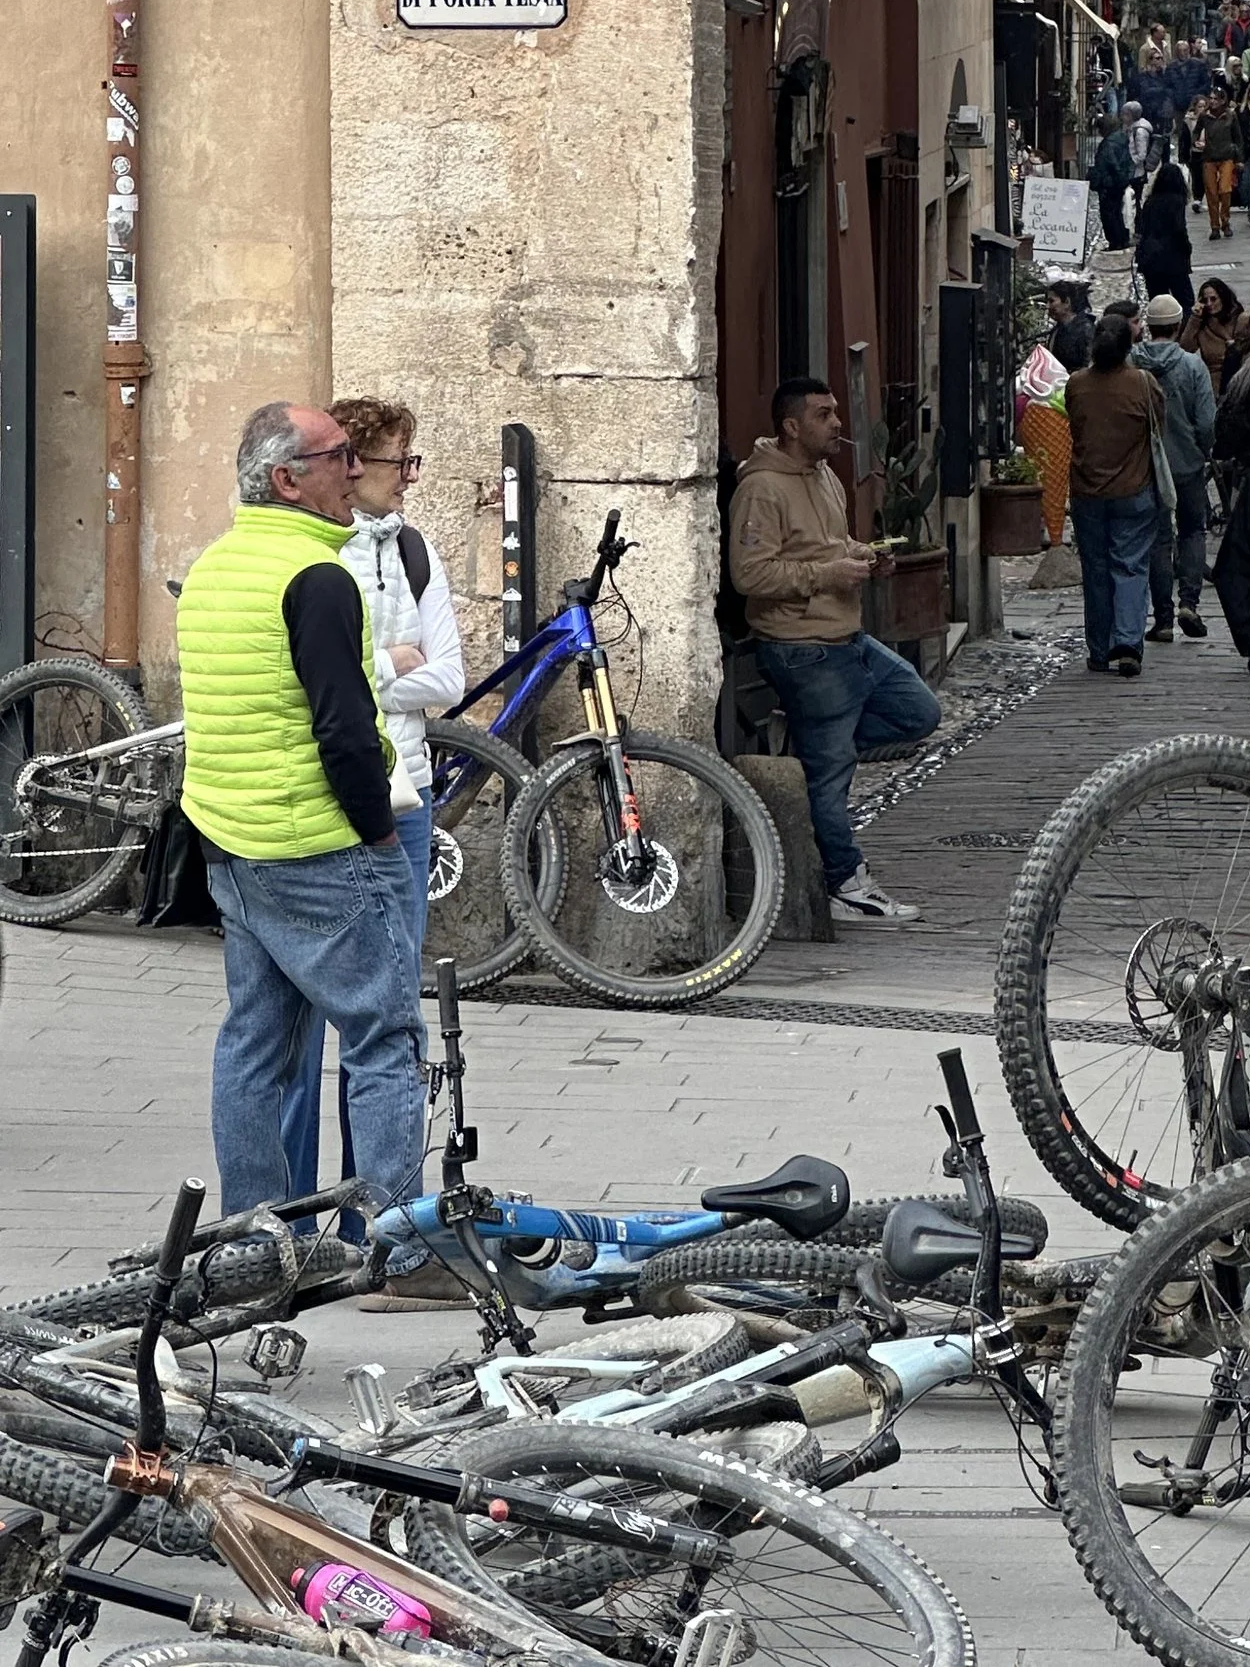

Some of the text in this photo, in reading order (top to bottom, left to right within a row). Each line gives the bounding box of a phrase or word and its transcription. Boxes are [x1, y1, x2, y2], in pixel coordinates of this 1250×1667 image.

[1028, 216, 1078, 233] Locanda
[685, 948, 744, 987] MAXXIS
[698, 1450, 827, 1508] MAXXIS
